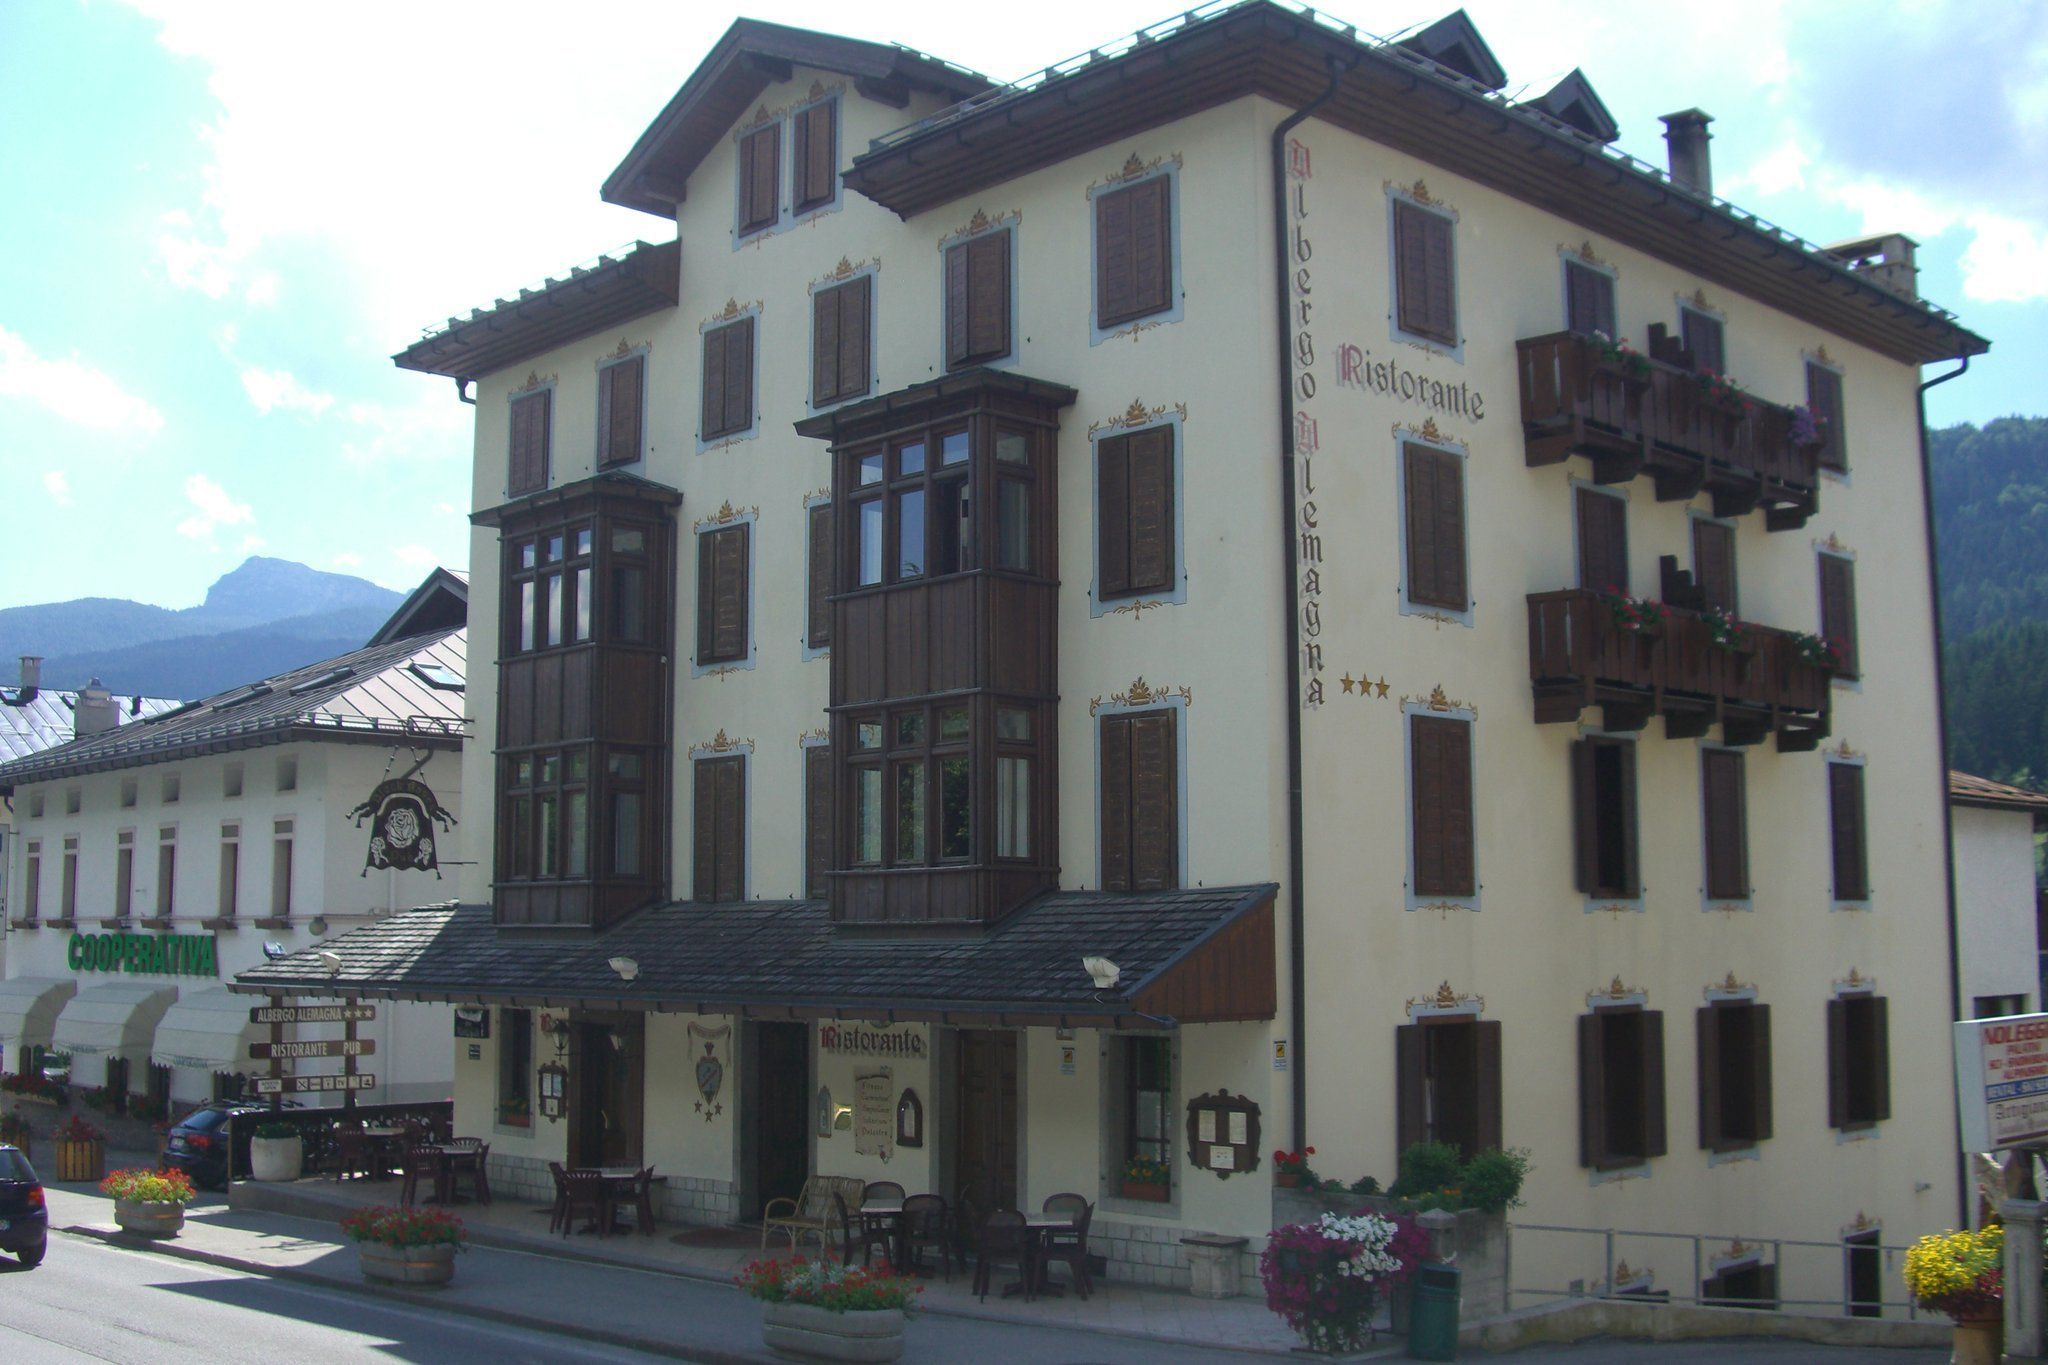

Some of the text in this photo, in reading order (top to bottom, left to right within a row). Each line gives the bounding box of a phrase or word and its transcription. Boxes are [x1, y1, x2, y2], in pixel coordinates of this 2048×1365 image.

[1339, 342, 1484, 420] Ristorante
[68, 932, 220, 977] COOPERATIVA
[257, 1006, 341, 1022] ALBERGO ALEMAGNA
[271, 1041, 361, 1057] RISTORANTE PUB
[820, 1024, 921, 1053] Ristorante
